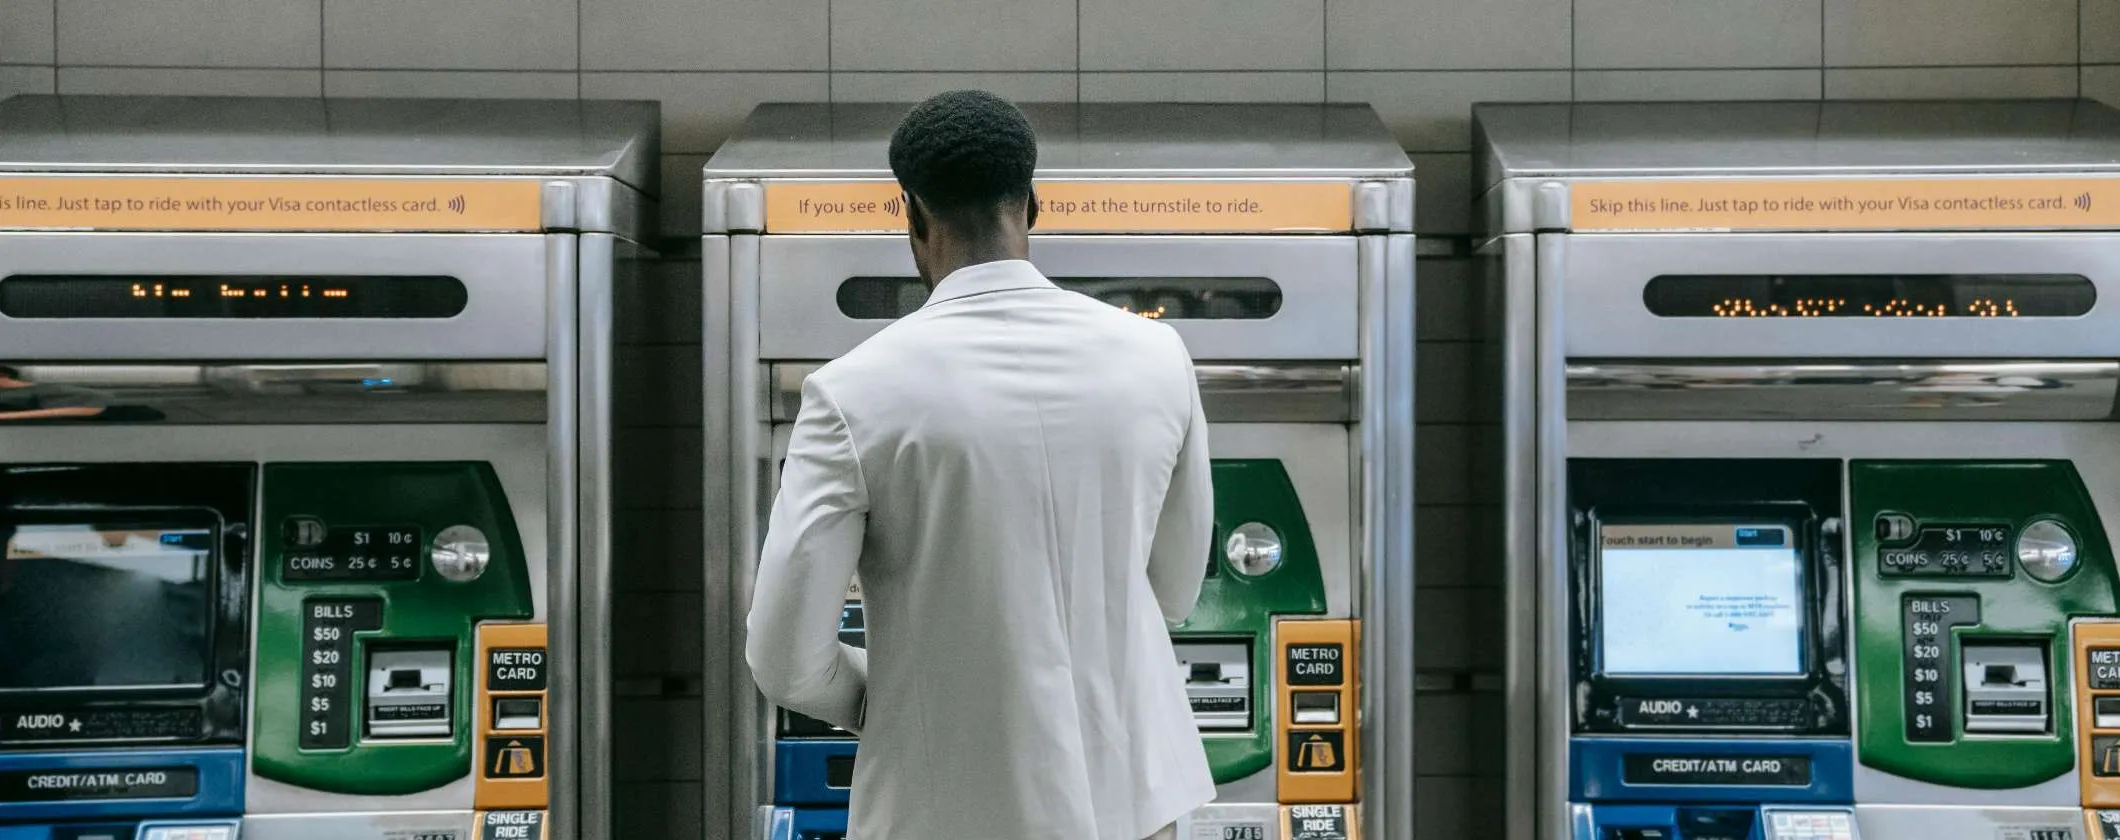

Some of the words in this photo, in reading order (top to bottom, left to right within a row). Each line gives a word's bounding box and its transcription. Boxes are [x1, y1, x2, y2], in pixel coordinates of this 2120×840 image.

[0, 196, 11, 211] is
[16, 196, 51, 211] line.
[56, 196, 89, 211] Just
[94, 198, 122, 216] tap
[127, 198, 144, 211] to
[149, 196, 181, 211] ride
[186, 196, 222, 211] with
[227, 200, 264, 216] your
[268, 197, 301, 212] Visa
[306, 197, 397, 212] contactless
[402, 197, 441, 212] card.
[799, 199, 811, 213] If
[814, 202, 844, 217] you
[850, 202, 876, 213] see
[1050, 199, 1076, 216] tap
[1081, 200, 1098, 213] at
[1101, 198, 1129, 213] the
[1133, 198, 1200, 213] turnstile
[1206, 200, 1222, 213] to
[1227, 198, 1264, 213] ride.
[1590, 198, 1623, 216] Skip
[1628, 198, 1656, 213] this
[1660, 198, 1692, 213] line.
[1698, 198, 1728, 213] Just
[1733, 199, 1758, 215] tap
[1763, 199, 1779, 212] to
[1784, 197, 1814, 212] ride
[1819, 197, 1854, 211] with
[1858, 200, 1894, 215] your
[1897, 197, 1929, 211] Visa
[1934, 196, 2024, 211] contactless
[2028, 196, 2067, 211] card.
[1600, 536, 1635, 546] Touch
[1638, 536, 1663, 546] start
[1666, 536, 1678, 546] to
[1681, 536, 1713, 548] begin
[290, 557, 335, 570] COINS
[1886, 553, 1928, 566] COINS
[314, 606, 353, 618] BILLS
[1912, 601, 1950, 613] BILLS
[313, 627, 340, 641] $50
[1913, 622, 1938, 635] $50
[312, 650, 339, 664] $20
[493, 652, 542, 665] METRO
[1291, 648, 1338, 660] METRO
[1914, 646, 1940, 659] $20
[2092, 651, 2120, 663] MET
[496, 667, 536, 680] CARD
[1296, 663, 1334, 675] CARD
[1915, 669, 1938, 682] $10
[312, 674, 336, 688] $10
[311, 697, 329, 711] $5
[1915, 692, 1933, 705] $5
[1639, 701, 1682, 714] AUDIO
[17, 714, 64, 729] AUDIO
[1916, 714, 1932, 728] $1
[311, 721, 327, 735] $1
[1653, 760, 1737, 772] CREDIT/ATM
[1742, 760, 1781, 773] CARD
[28, 774, 119, 789] CREDIT/ATM
[125, 772, 167, 785] CARD
[487, 813, 538, 825] SINGLE
[1291, 807, 1341, 818] SINGLE
[495, 826, 529, 838] RIDE
[1303, 820, 1335, 831] RIDE
